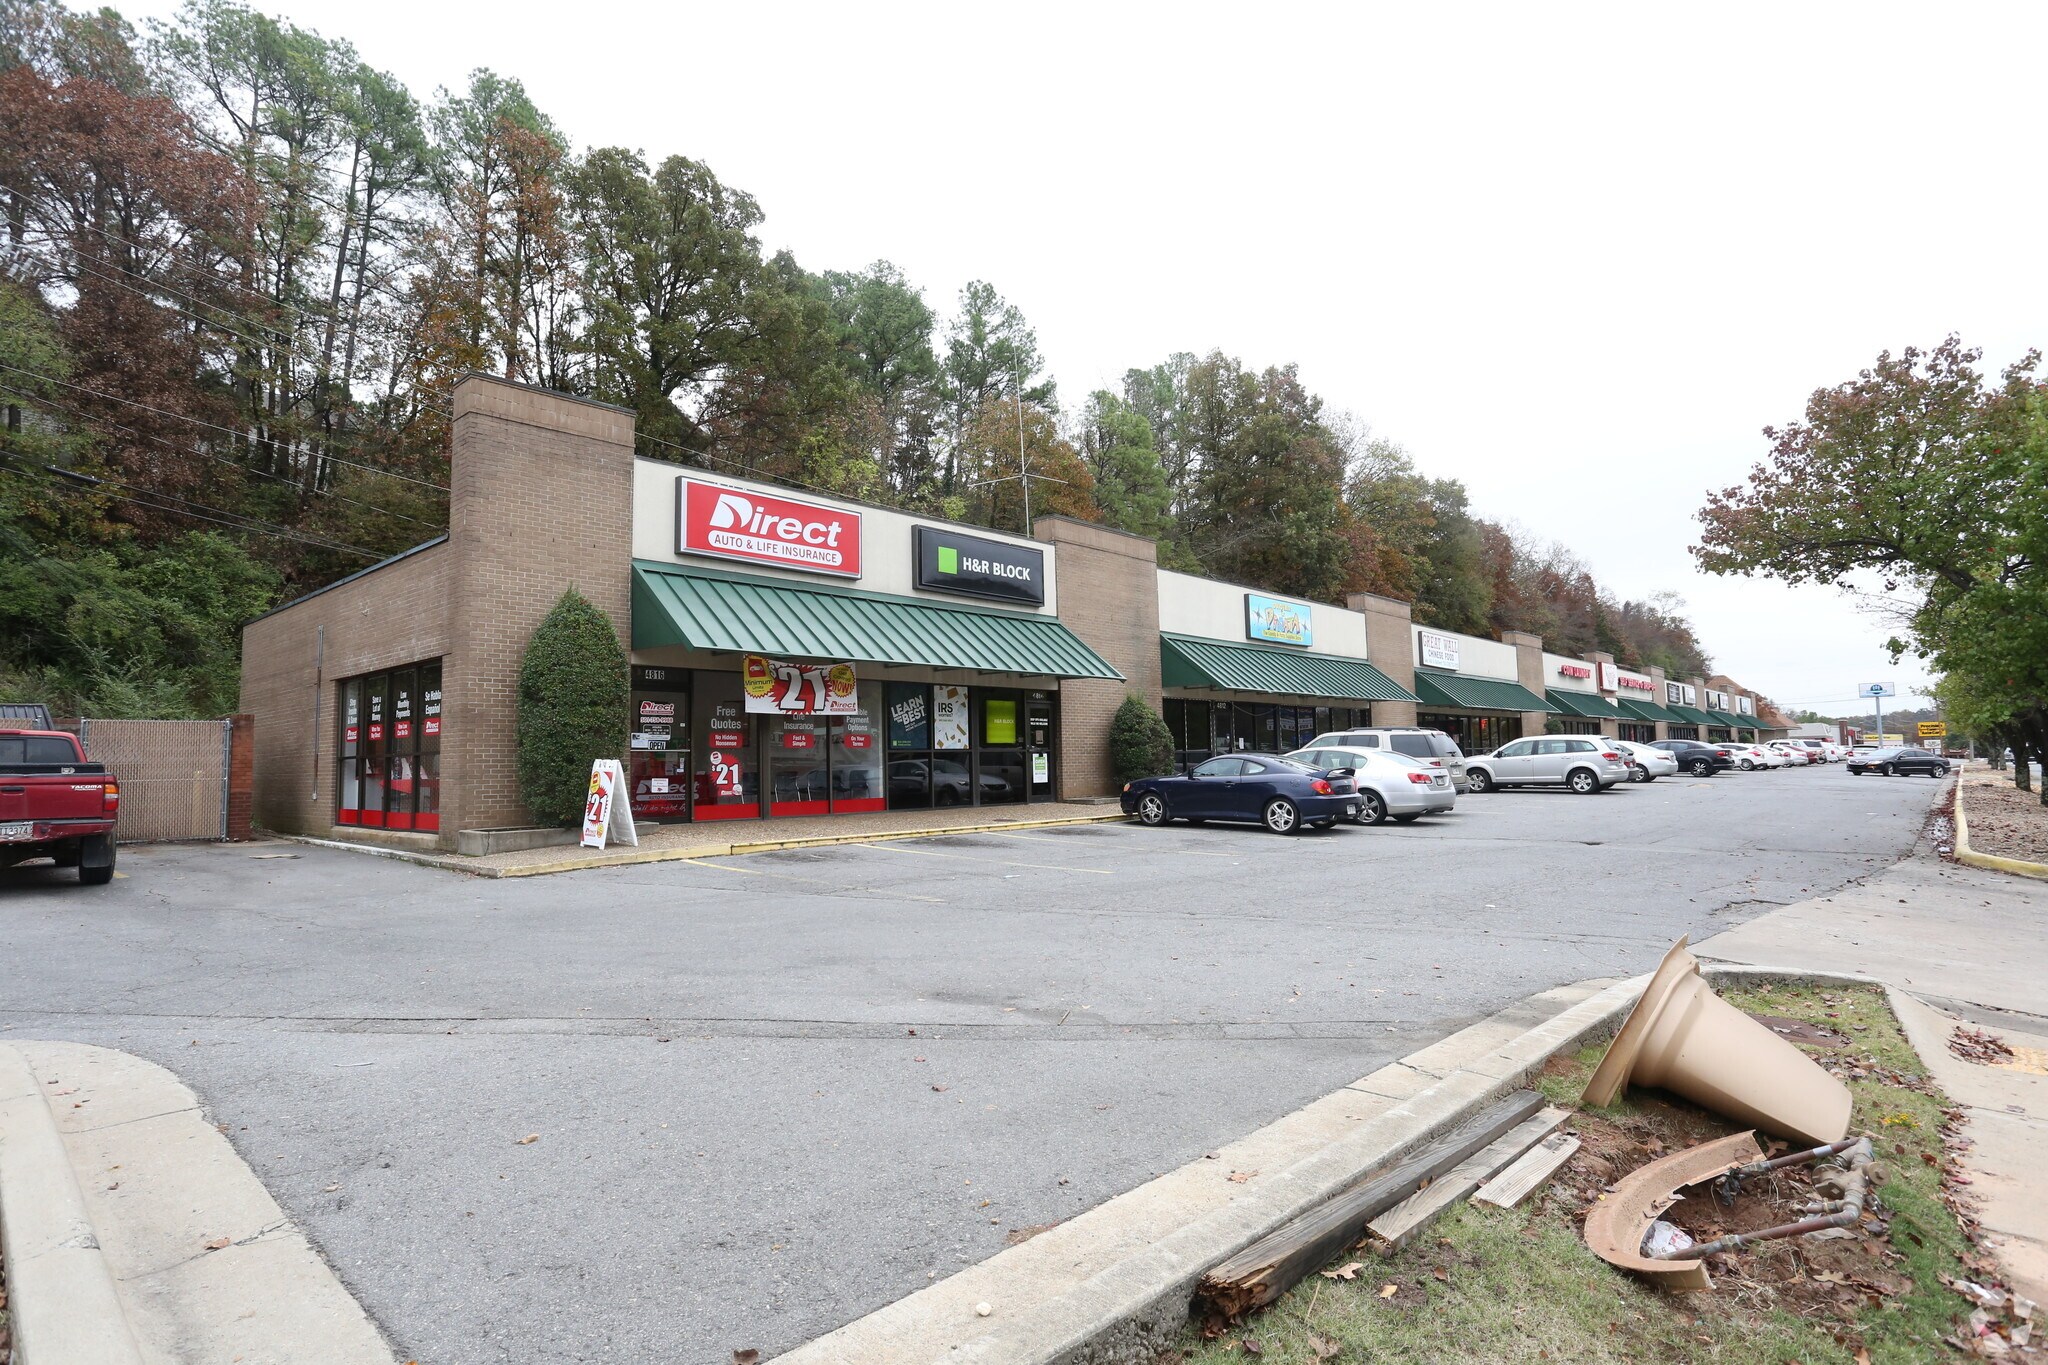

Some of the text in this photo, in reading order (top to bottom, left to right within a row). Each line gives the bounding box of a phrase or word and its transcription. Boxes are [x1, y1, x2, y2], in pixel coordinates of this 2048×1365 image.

[709, 494, 842, 548] Direct
[714, 534, 837, 563] AUTO & LIFE INSURANCE
[963, 557, 1031, 580] H&R BLOCK
[1423, 634, 1458, 653] GREAT WALL
[1428, 649, 1454, 662] CHINESE FOOD
[645, 670, 664, 680] 4816
[1562, 665, 1590, 678] COIN LAUNDRY
[831, 681, 853, 693] NOW!
[425, 690, 441, 701] Se Habla
[425, 704, 440, 716] Español
[641, 701, 674, 711] Direct
[830, 701, 856, 709] Direct
[890, 694, 924, 718] LEARN
[938, 702, 953, 713] IRS
[716, 706, 736, 716] Free
[902, 706, 926, 726] BEST
[711, 718, 742, 729] Quotes
[784, 722, 814, 730] Insurance
[846, 716, 870, 725] Payment
[848, 724, 868, 732] Options
[650, 742, 665, 750] OPEN
